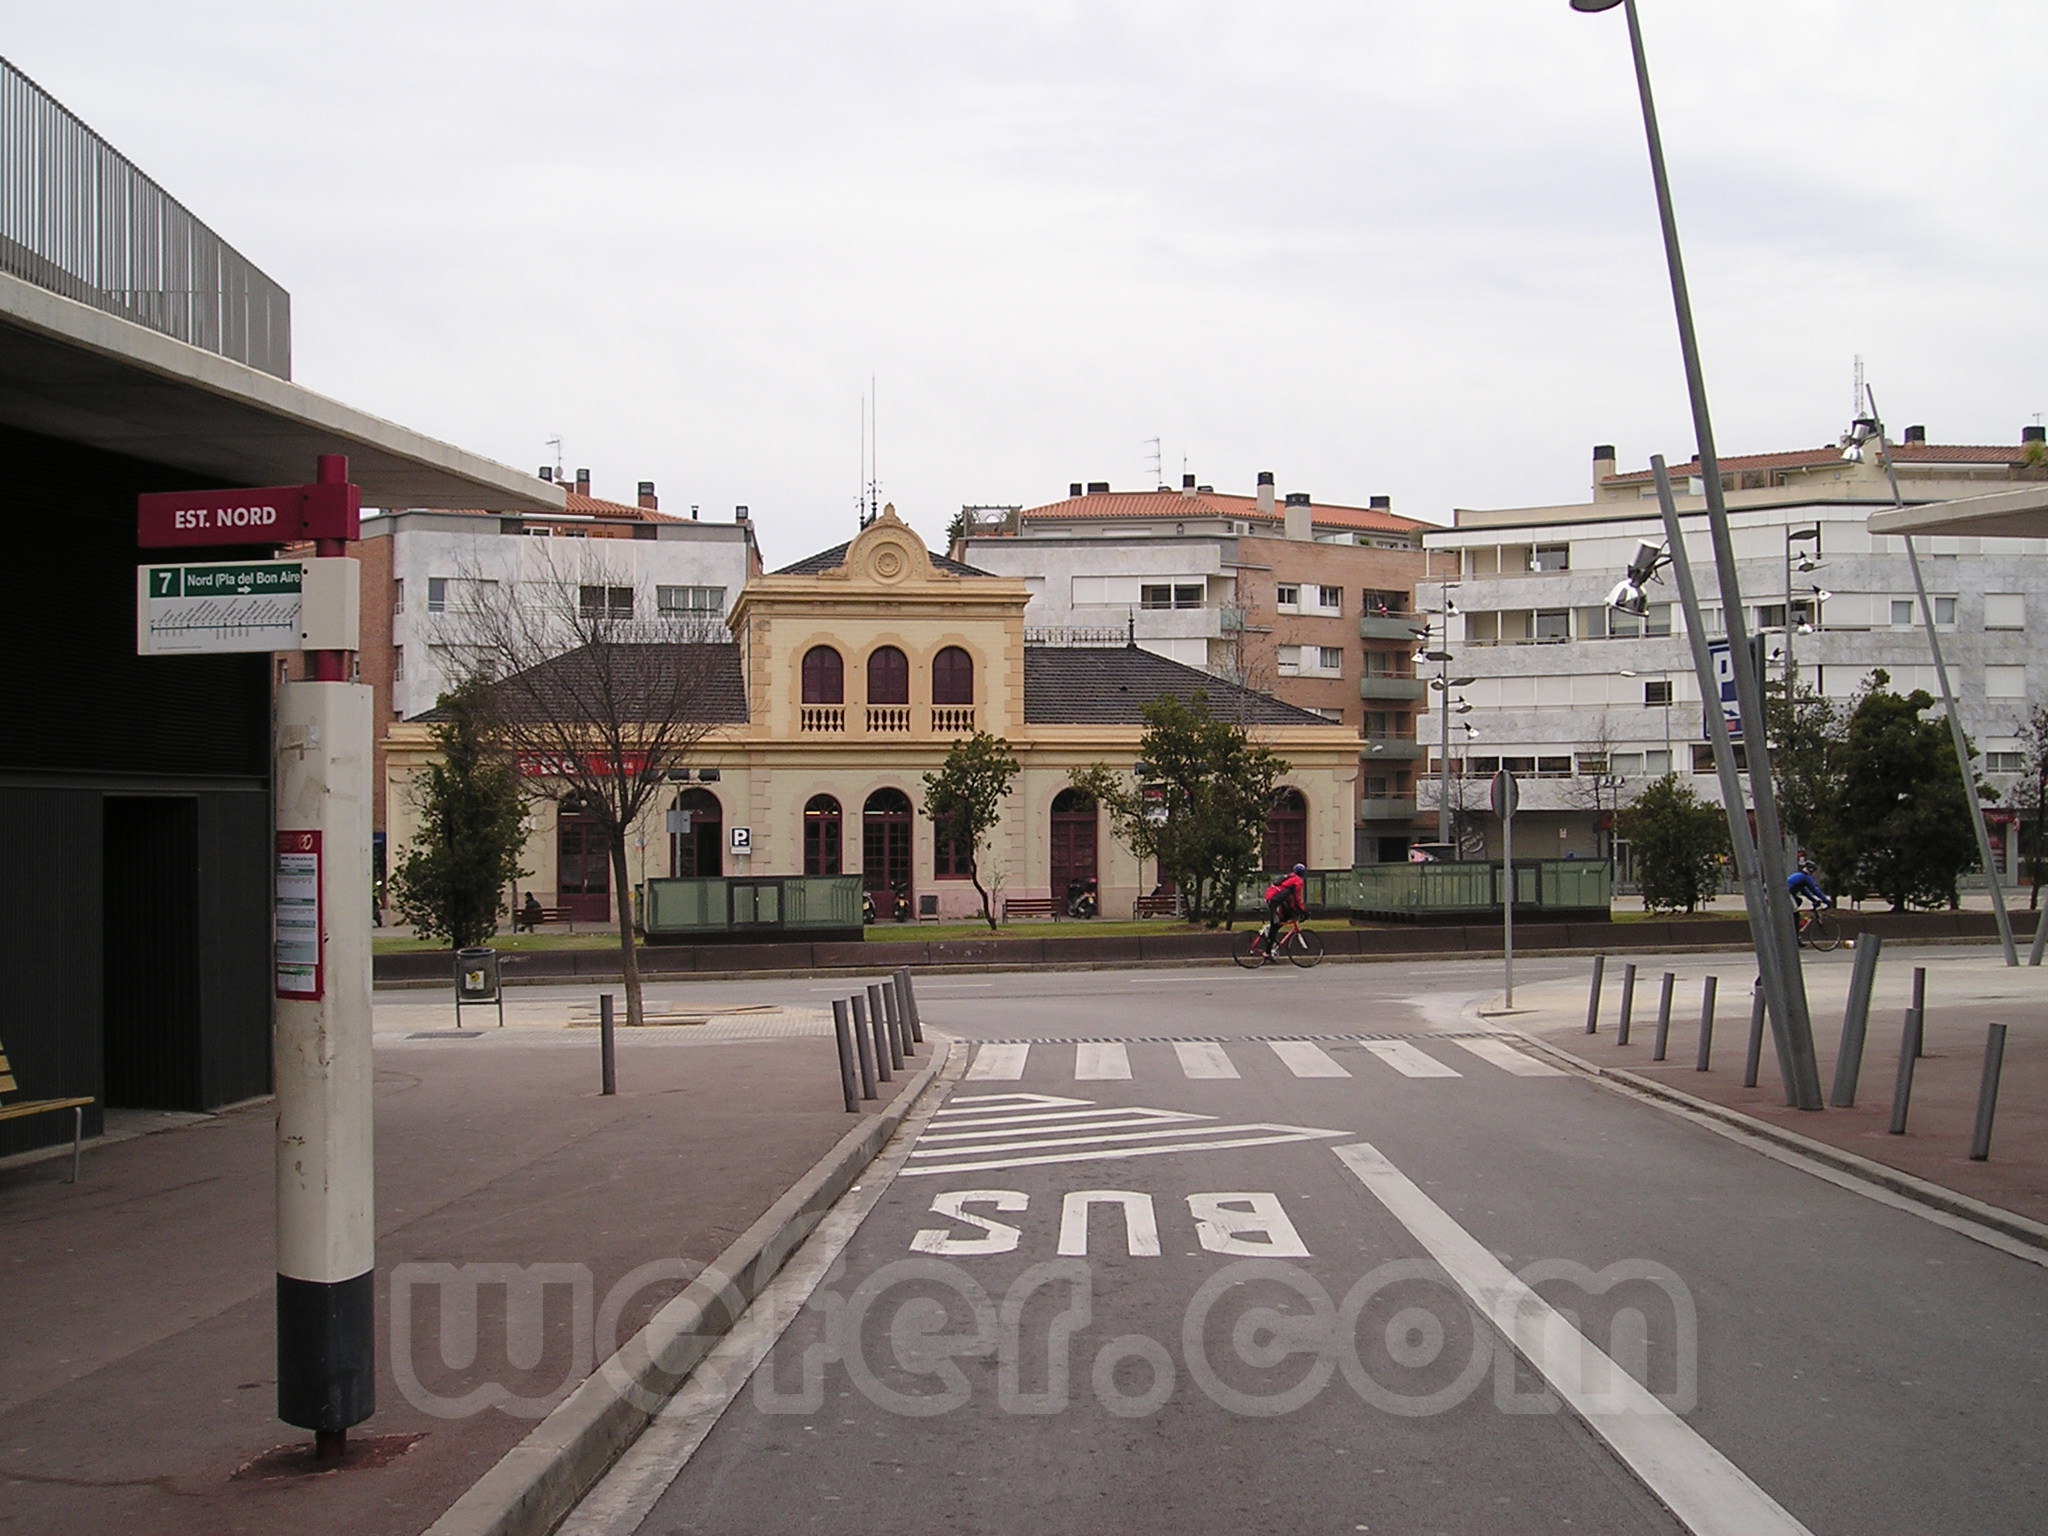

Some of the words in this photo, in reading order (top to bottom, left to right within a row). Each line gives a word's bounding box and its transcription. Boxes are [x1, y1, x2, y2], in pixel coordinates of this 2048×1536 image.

[175, 509, 210, 529] EST.
[217, 506, 277, 527] NORD
[159, 572, 172, 594] 7
[187, 573, 213, 587] Nord
[237, 572, 255, 585] del
[256, 571, 278, 584] Bon
[1713, 650, 1736, 700] P
[734, 829, 748, 845] P
[908, 1190, 1311, 1258] BUS
